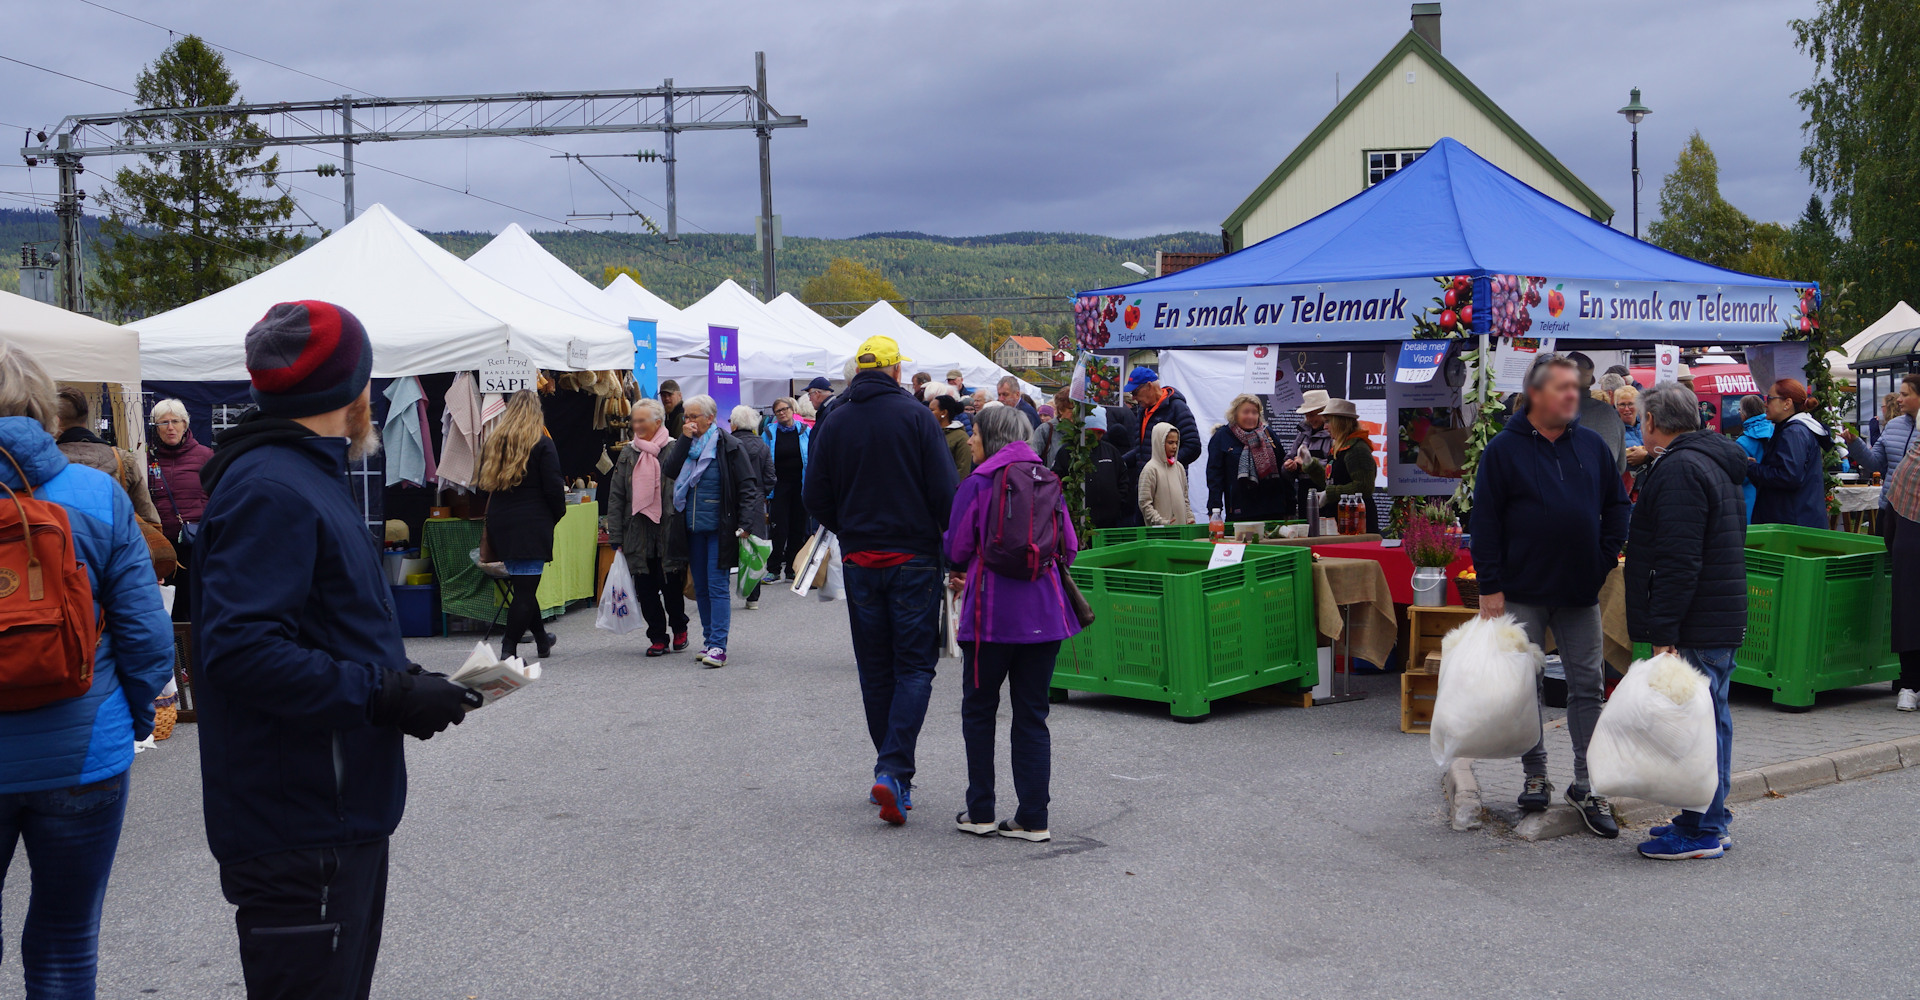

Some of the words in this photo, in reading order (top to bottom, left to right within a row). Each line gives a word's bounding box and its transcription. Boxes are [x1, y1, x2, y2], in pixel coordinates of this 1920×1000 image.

[1154, 302, 1181, 330] En
[1186, 296, 1249, 328] smak
[1254, 303, 1285, 326] av
[1291, 288, 1408, 325] Telemark
[1579, 290, 1605, 320] En
[1610, 290, 1664, 322] smak
[1668, 300, 1693, 323] av
[1696, 293, 1779, 324] Telemark
[1540, 321, 1570, 334] Telefrukt
[1118, 332, 1146, 345] Telefrukt
[1404, 342, 1427, 351] betale
[1428, 342, 1447, 351] med
[487, 358, 505, 367] Ren
[507, 356, 528, 368] Fryd
[1413, 353, 1433, 364] Vipps
[486, 376, 530, 391] SÅPE
[1294, 371, 1326, 384] GNA
[1714, 374, 1760, 393] BONDE
